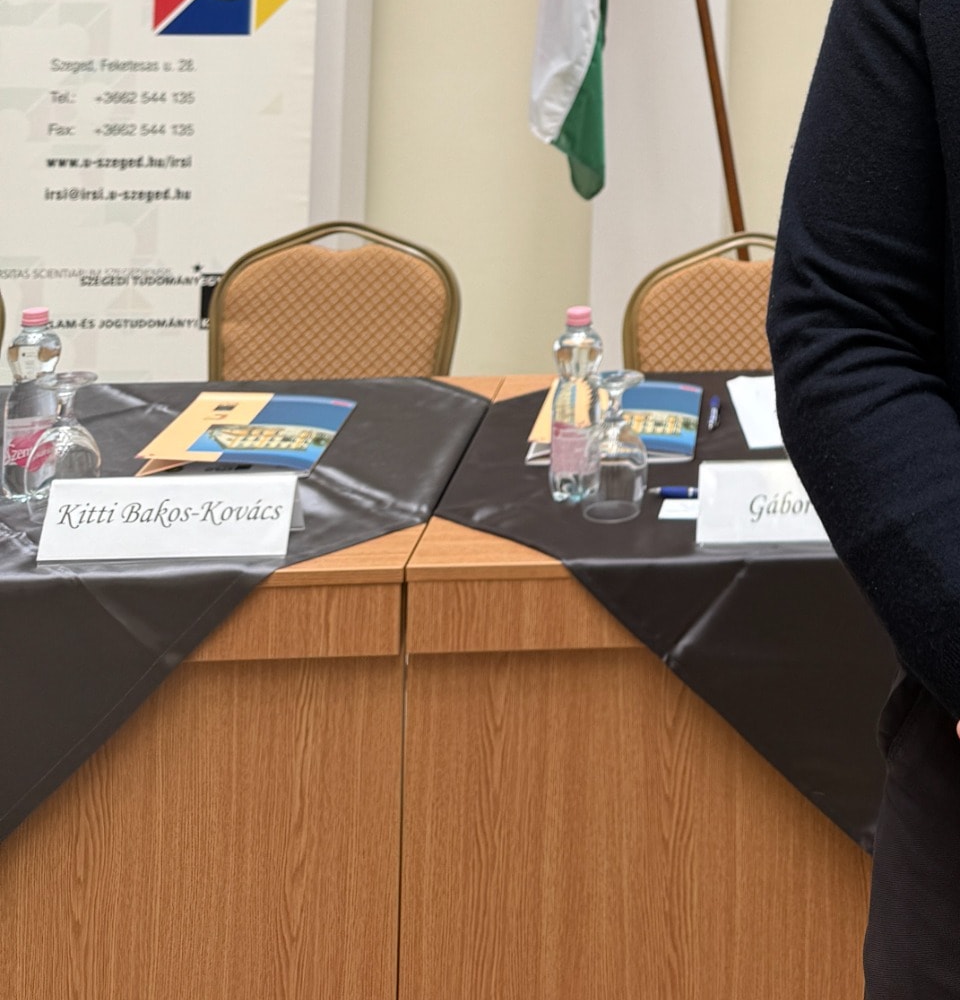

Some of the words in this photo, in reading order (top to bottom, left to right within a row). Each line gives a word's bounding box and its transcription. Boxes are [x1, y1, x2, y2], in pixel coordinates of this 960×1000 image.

[46, 155, 192, 170] www.u-szeged.hu/irsi
[44, 187, 191, 203] irsi@irsi.u-szeged.hu
[57, 502, 118, 529] Kitti
[121, 498, 283, 528] Bakos-Kovács
[749, 491, 811, 523] Gábor
